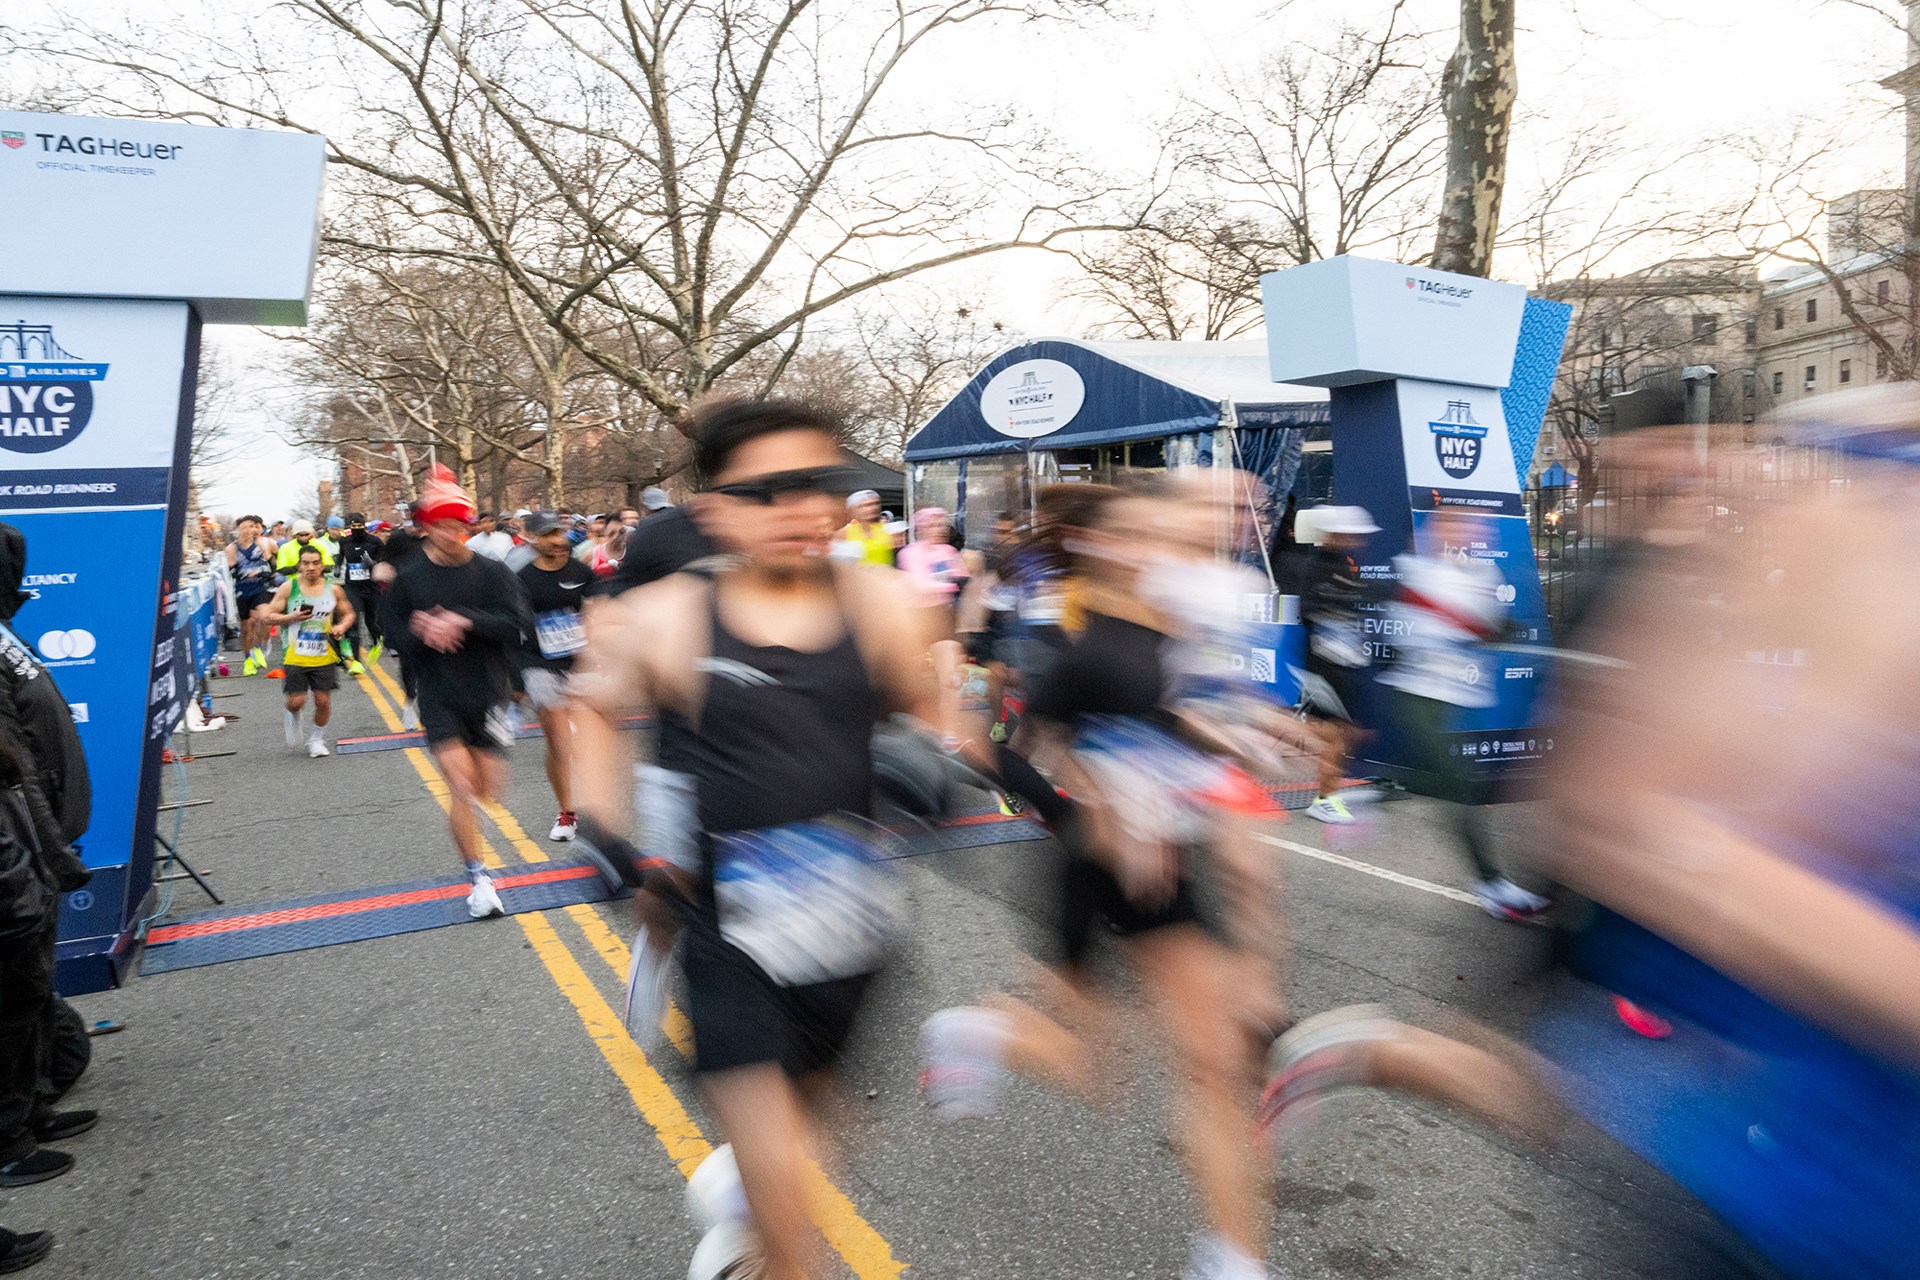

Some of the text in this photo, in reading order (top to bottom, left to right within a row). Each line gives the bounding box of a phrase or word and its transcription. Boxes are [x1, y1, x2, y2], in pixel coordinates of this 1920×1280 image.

[35, 160, 157, 176] OFFICIAL TIMEKEEPER
[27, 368, 98, 376] AIRLINES
[1440, 437, 1477, 457] NYC
[1443, 456, 1474, 470] HALF
[13, 485, 53, 495] ROAD
[53, 483, 117, 494] RUNNERS
[1470, 549, 1509, 558] CONSULTANCY
[1376, 572, 1404, 580] RUNNERS
[1364, 618, 1415, 636] EVERY
[1504, 667, 1534, 679] ESPN
